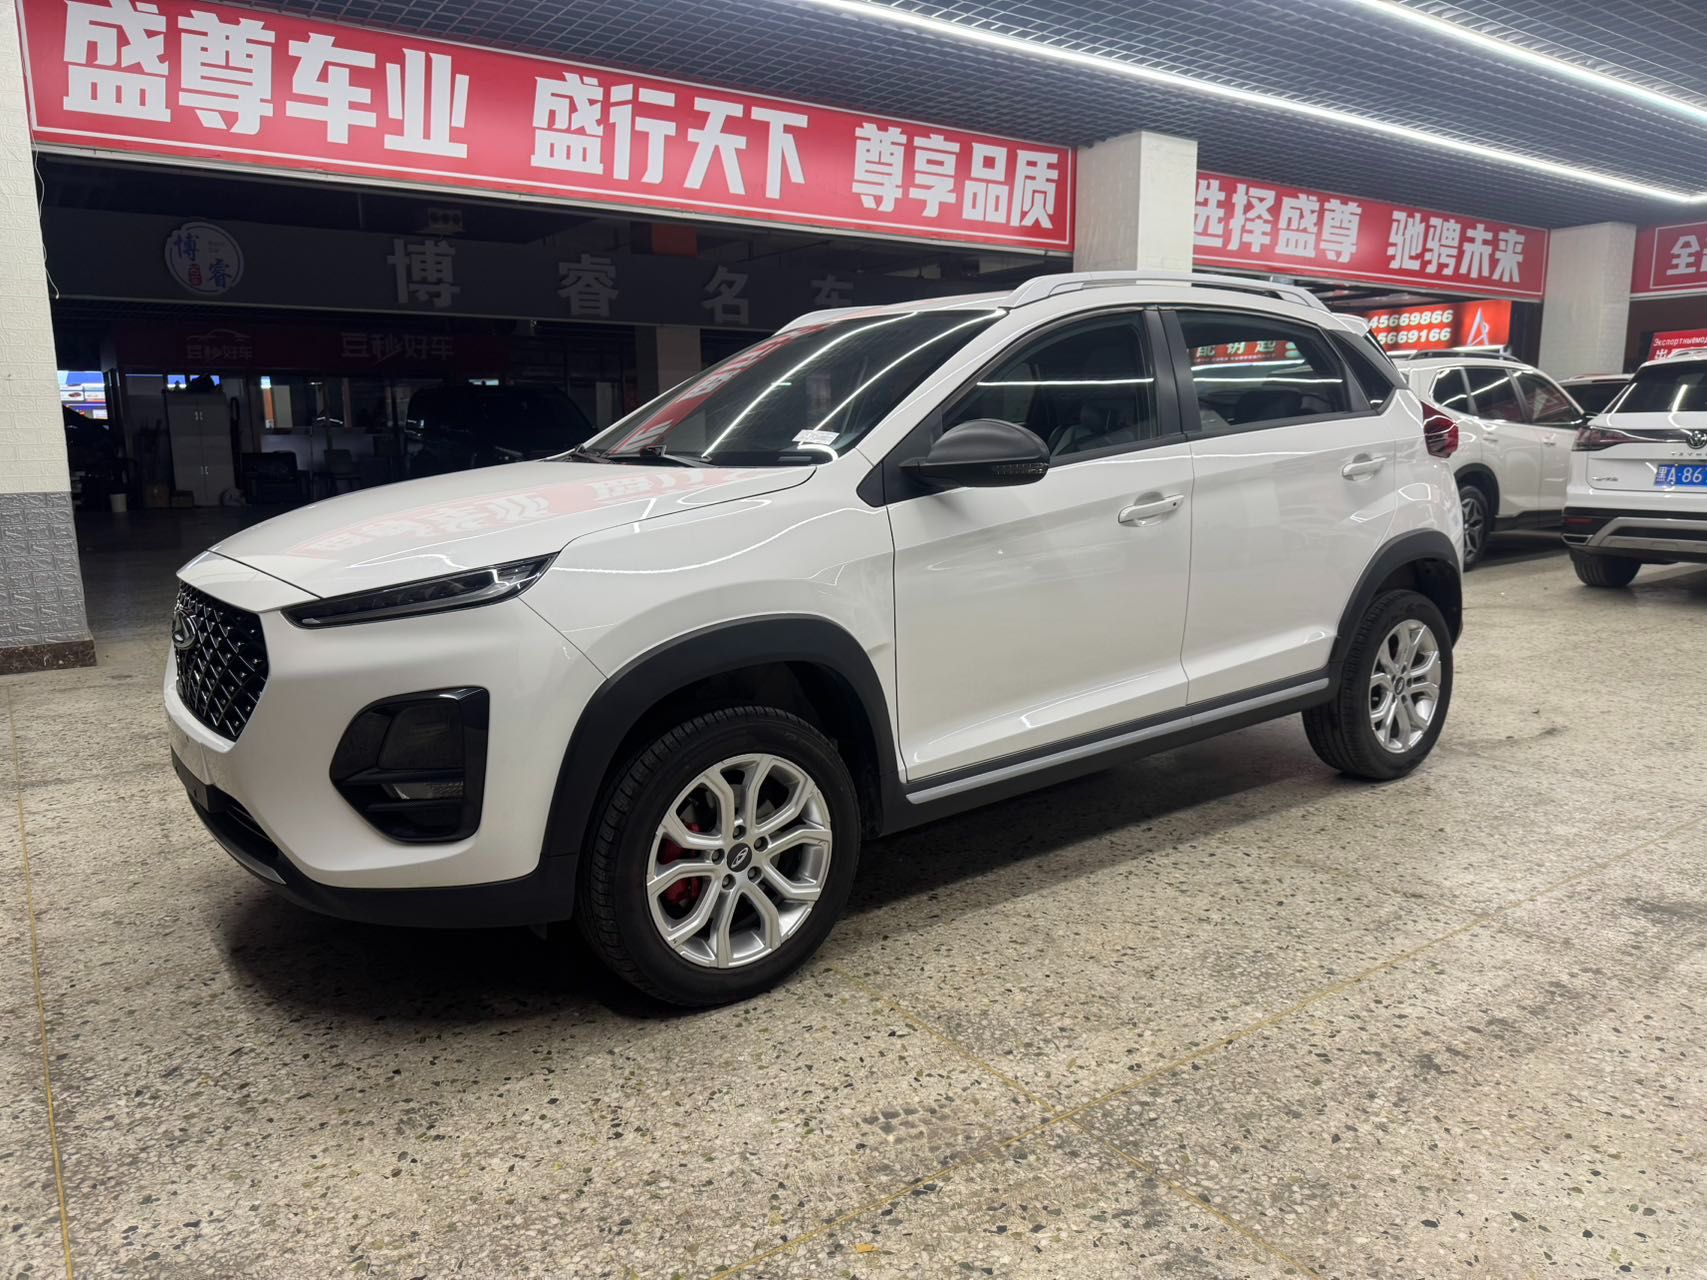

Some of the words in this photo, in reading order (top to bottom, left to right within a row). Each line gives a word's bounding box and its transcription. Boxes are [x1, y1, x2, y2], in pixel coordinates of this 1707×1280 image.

[62, 0, 470, 159] 盛尊车业
[530, 71, 809, 200] 盛行天下
[852, 122, 1059, 230] 尊享品质
[1193, 178, 1363, 264] 选择盛尊
[1386, 210, 1526, 284] 驰骋未来
[1666, 234, 1707, 275] 全
[1375, 327, 1452, 345] 5669166
